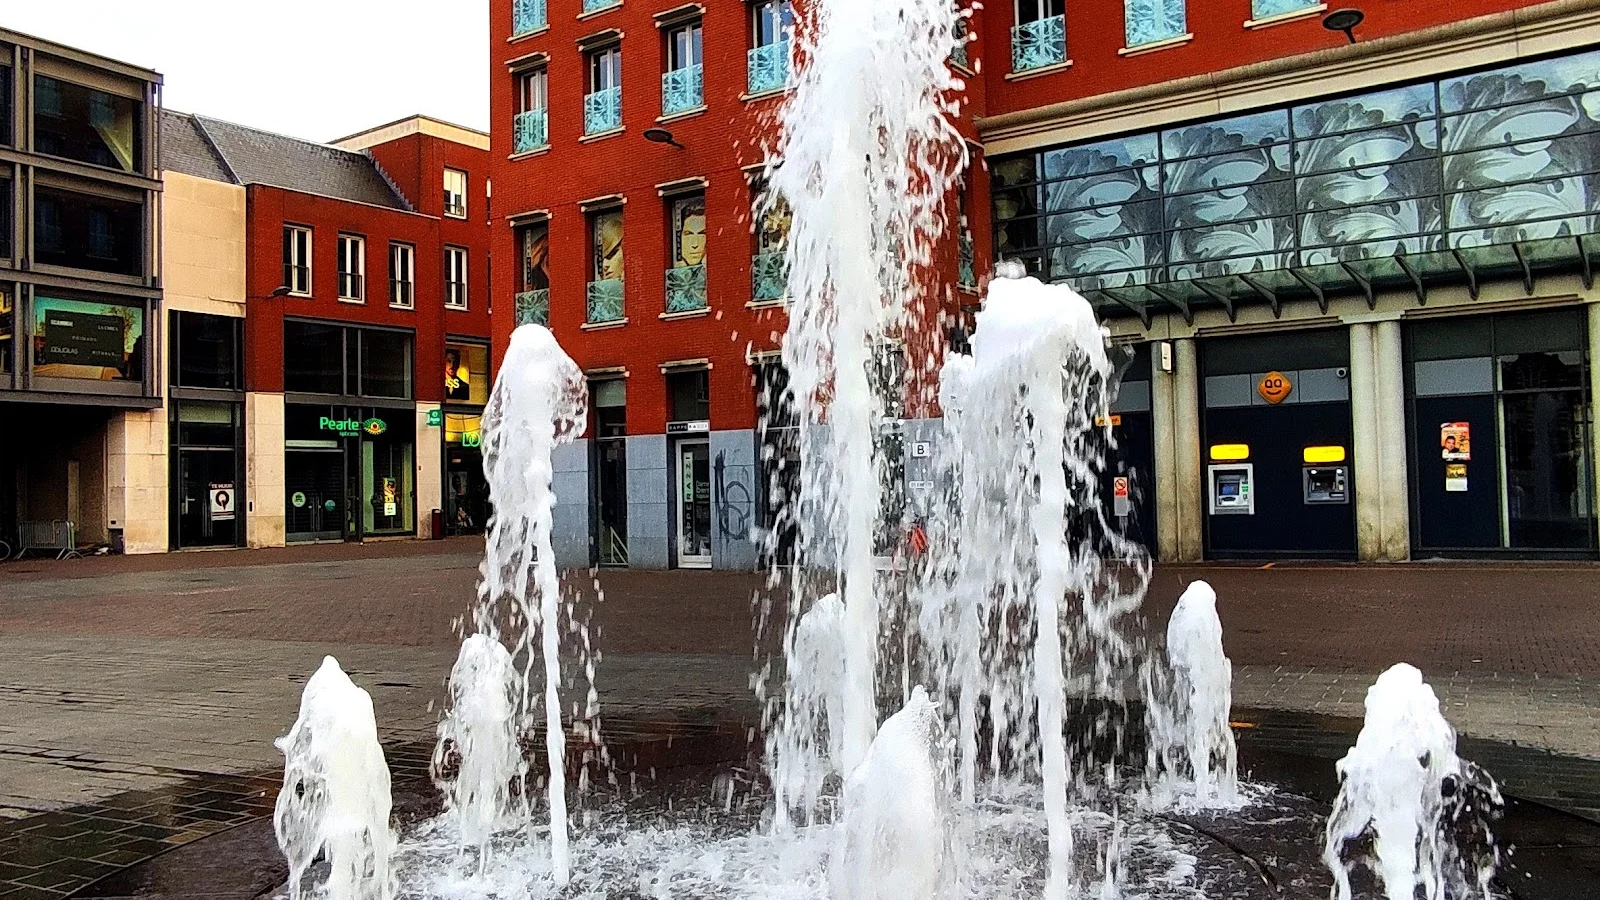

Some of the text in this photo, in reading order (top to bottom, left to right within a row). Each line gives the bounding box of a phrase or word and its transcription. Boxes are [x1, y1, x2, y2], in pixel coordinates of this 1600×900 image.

[51, 346, 78, 354] DOUGLAS
[319, 416, 360, 431] Pearle
[917, 445, 925, 455] B
